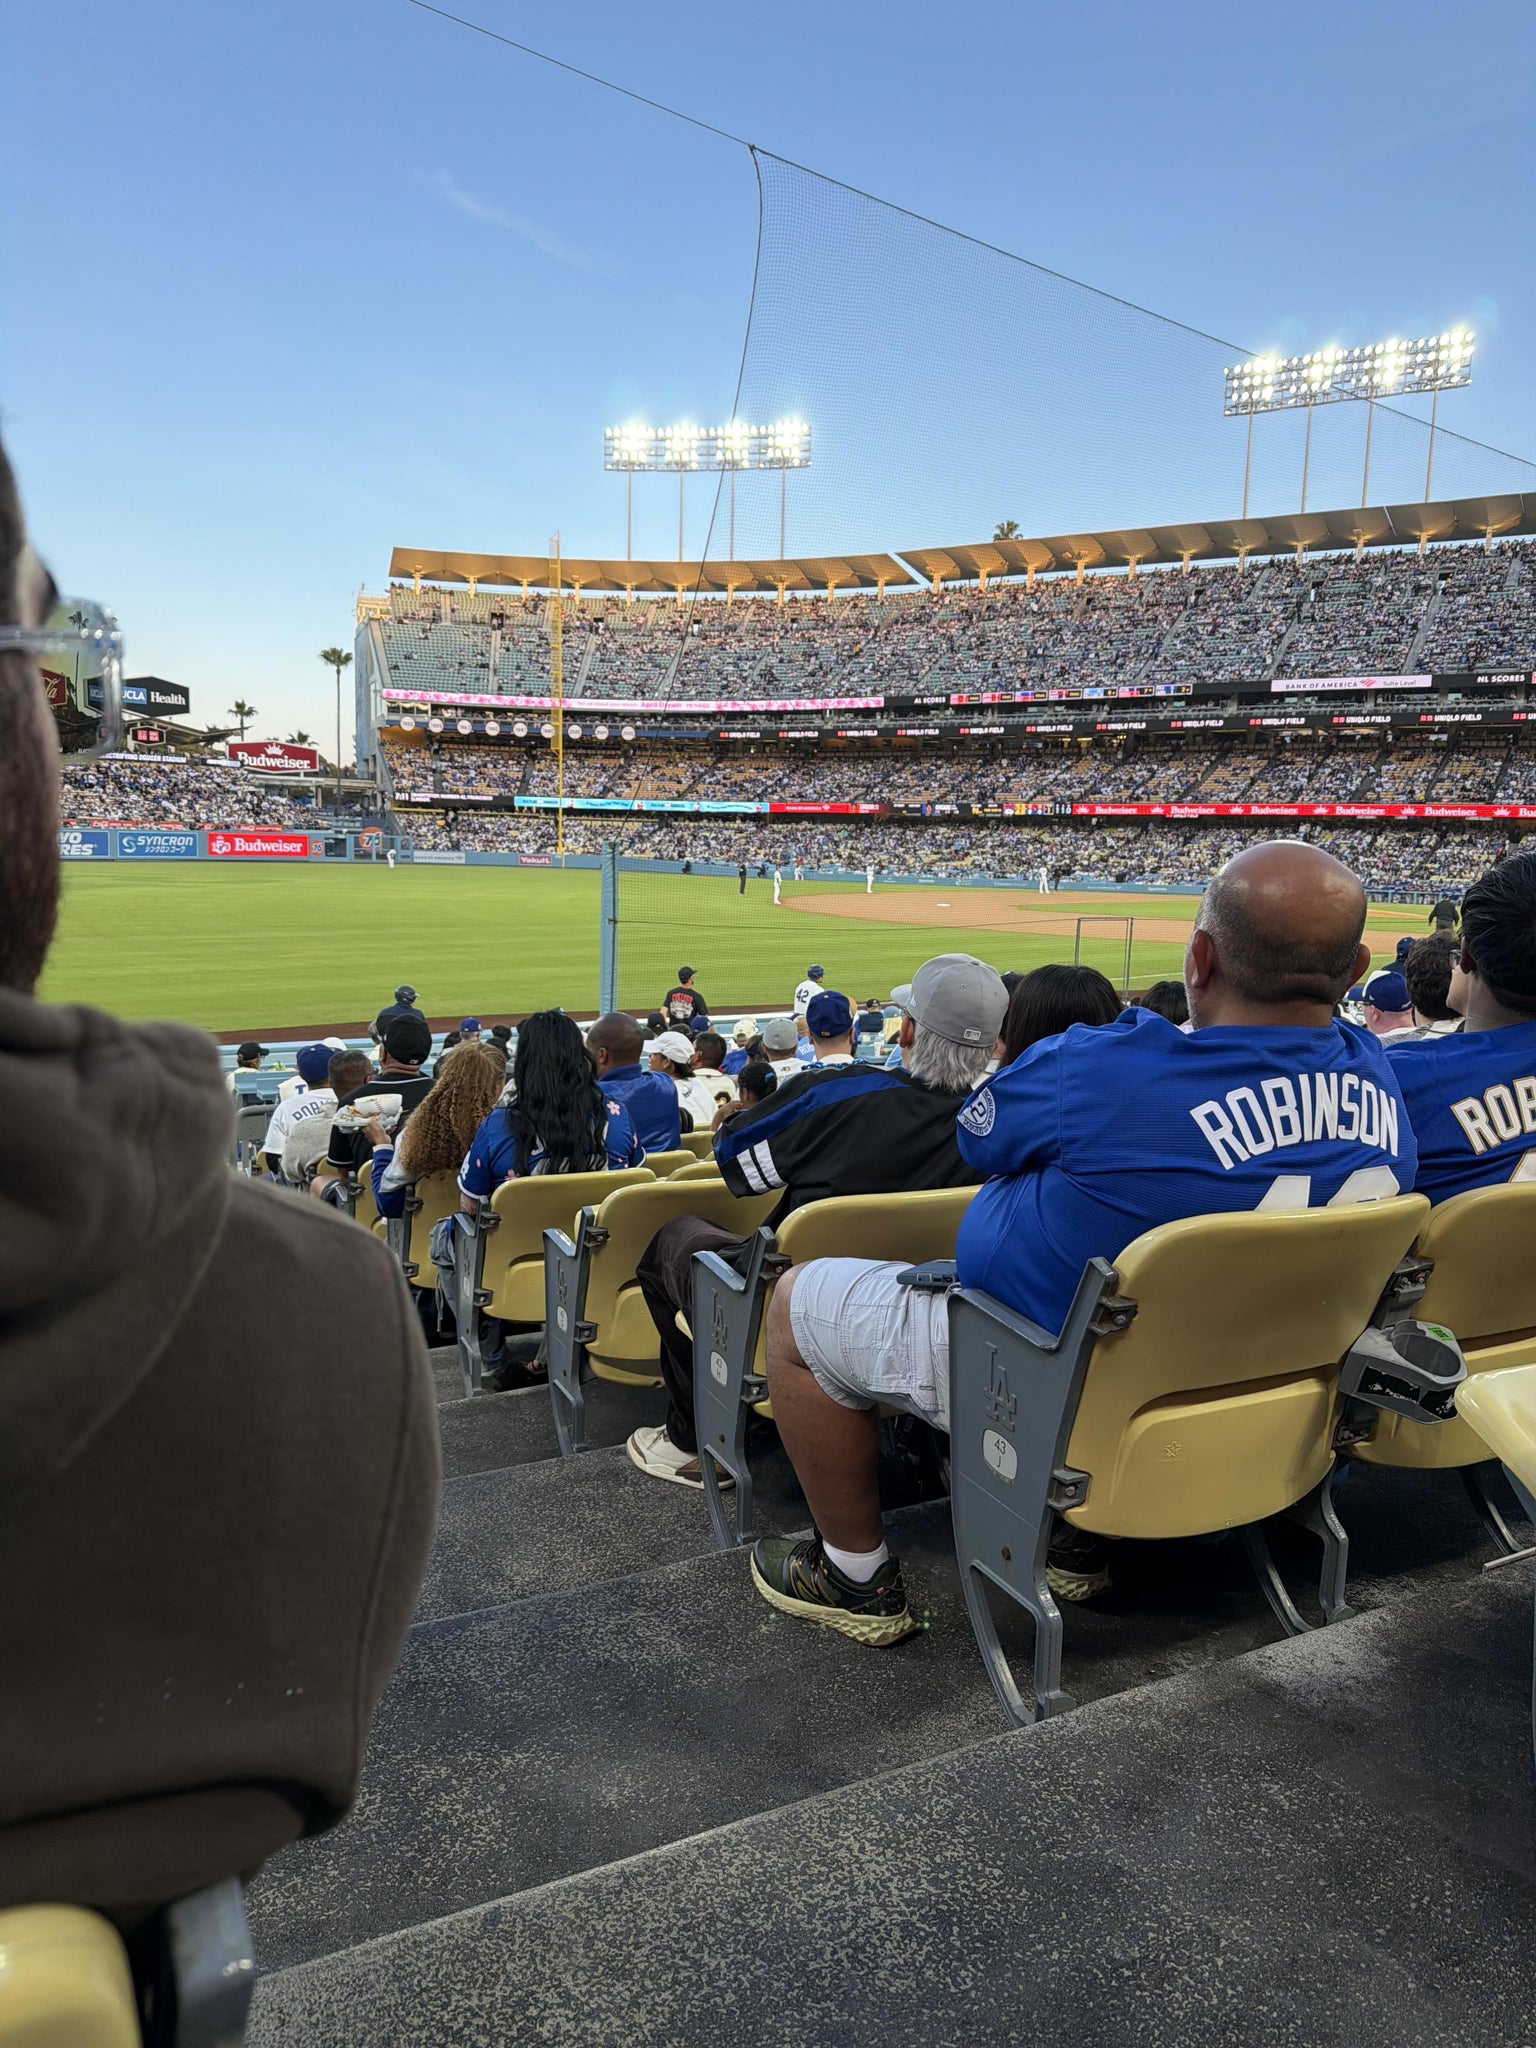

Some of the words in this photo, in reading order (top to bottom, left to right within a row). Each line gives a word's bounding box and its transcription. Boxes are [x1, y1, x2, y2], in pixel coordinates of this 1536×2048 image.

[1477, 675, 1489, 683] NL
[1491, 674, 1525, 683] SCORES
[1321, 681, 1358, 689] AMERICA
[150, 691, 186, 705] Health
[923, 696, 946, 704] SCORES
[1262, 718, 1285, 726] UNIQLO
[1346, 716, 1370, 724] UNIQLO
[1434, 714, 1459, 722] UNIQLO
[1108, 722, 1128, 730] UNIQLO
[1183, 720, 1204, 728] UNIQLO
[236, 751, 311, 769] Budweiser
[1095, 806, 1138, 814] Budweiser
[1171, 805, 1216, 814] Budweiser
[1251, 806, 1298, 815] Budweiser
[1335, 806, 1386, 815] Budweiser
[1425, 806, 1477, 816] Budweiser
[137, 836, 193, 846] SYNCRON
[233, 837, 304, 852] Budweiser
[60, 844, 94, 855] RES
[520, 855, 551, 864] Yakult
[796, 988, 809, 1004] 42
[970, 1101, 987, 1123] 2
[1450, 1076, 1536, 1155] ROB
[1189, 1072, 1399, 1171] ROBINSON
[984, 1340, 1017, 1433] LA
[993, 1438, 1007, 1455] 43
